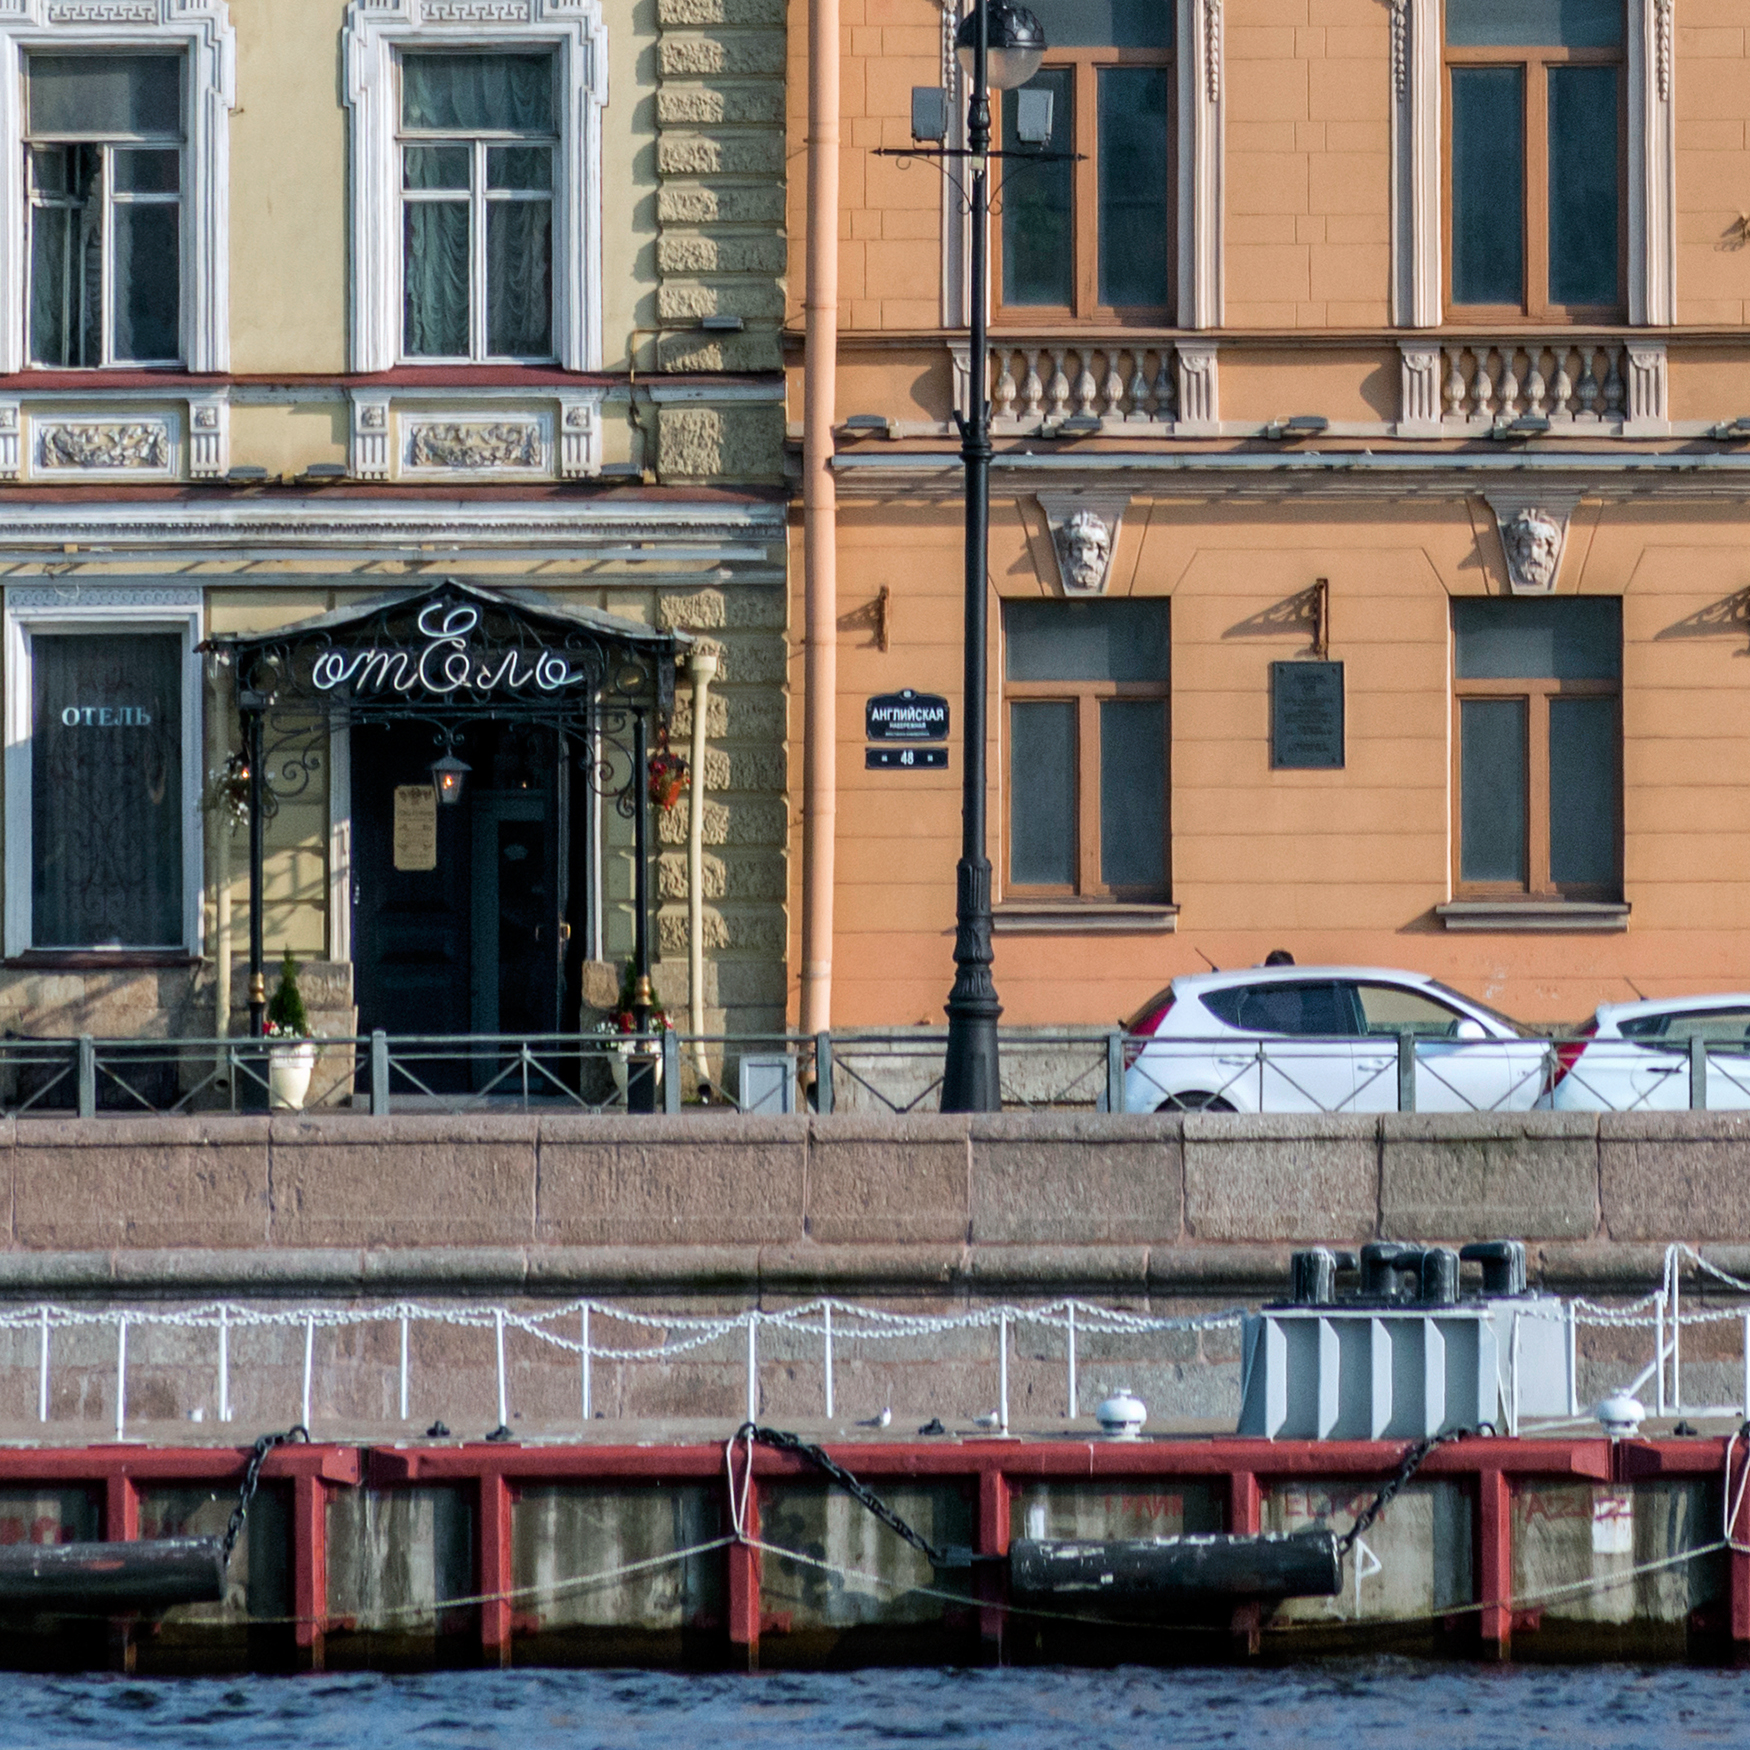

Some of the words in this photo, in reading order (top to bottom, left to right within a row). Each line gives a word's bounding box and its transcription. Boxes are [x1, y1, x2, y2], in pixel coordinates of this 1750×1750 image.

[61, 706, 152, 727] ОТЕЛЬ
[871, 705, 944, 721] АНГЛИЙСКАЯ
[900, 749, 914, 766] 48
